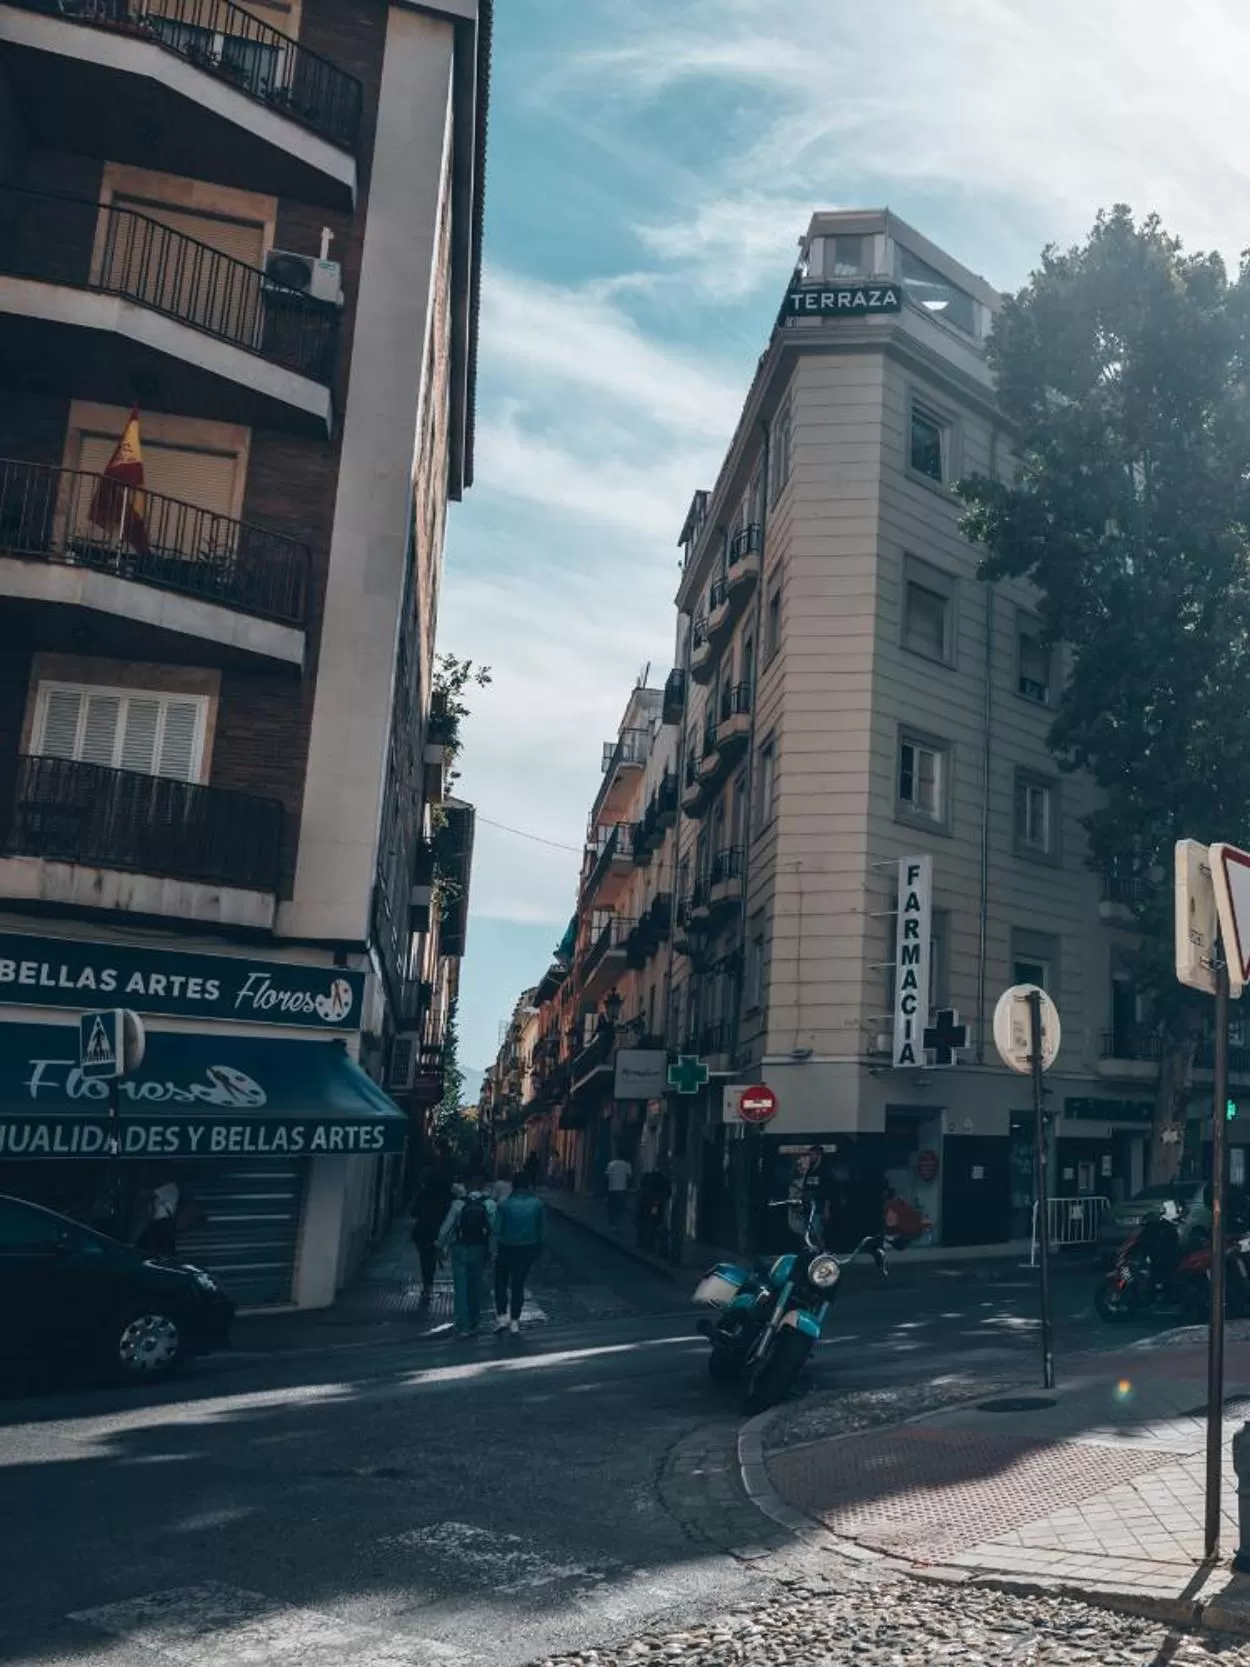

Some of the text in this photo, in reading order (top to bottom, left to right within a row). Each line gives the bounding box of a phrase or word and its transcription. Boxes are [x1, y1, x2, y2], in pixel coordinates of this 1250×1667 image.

[791, 290, 897, 310] TERRAZA
[900, 864, 920, 1064] FARMACIA
[0, 959, 316, 1013] BELLAS ARTES Flores
[187, 1125, 206, 1152] Y
[210, 1126, 304, 1152] BELLAS
[310, 1125, 384, 1150] ARTES
